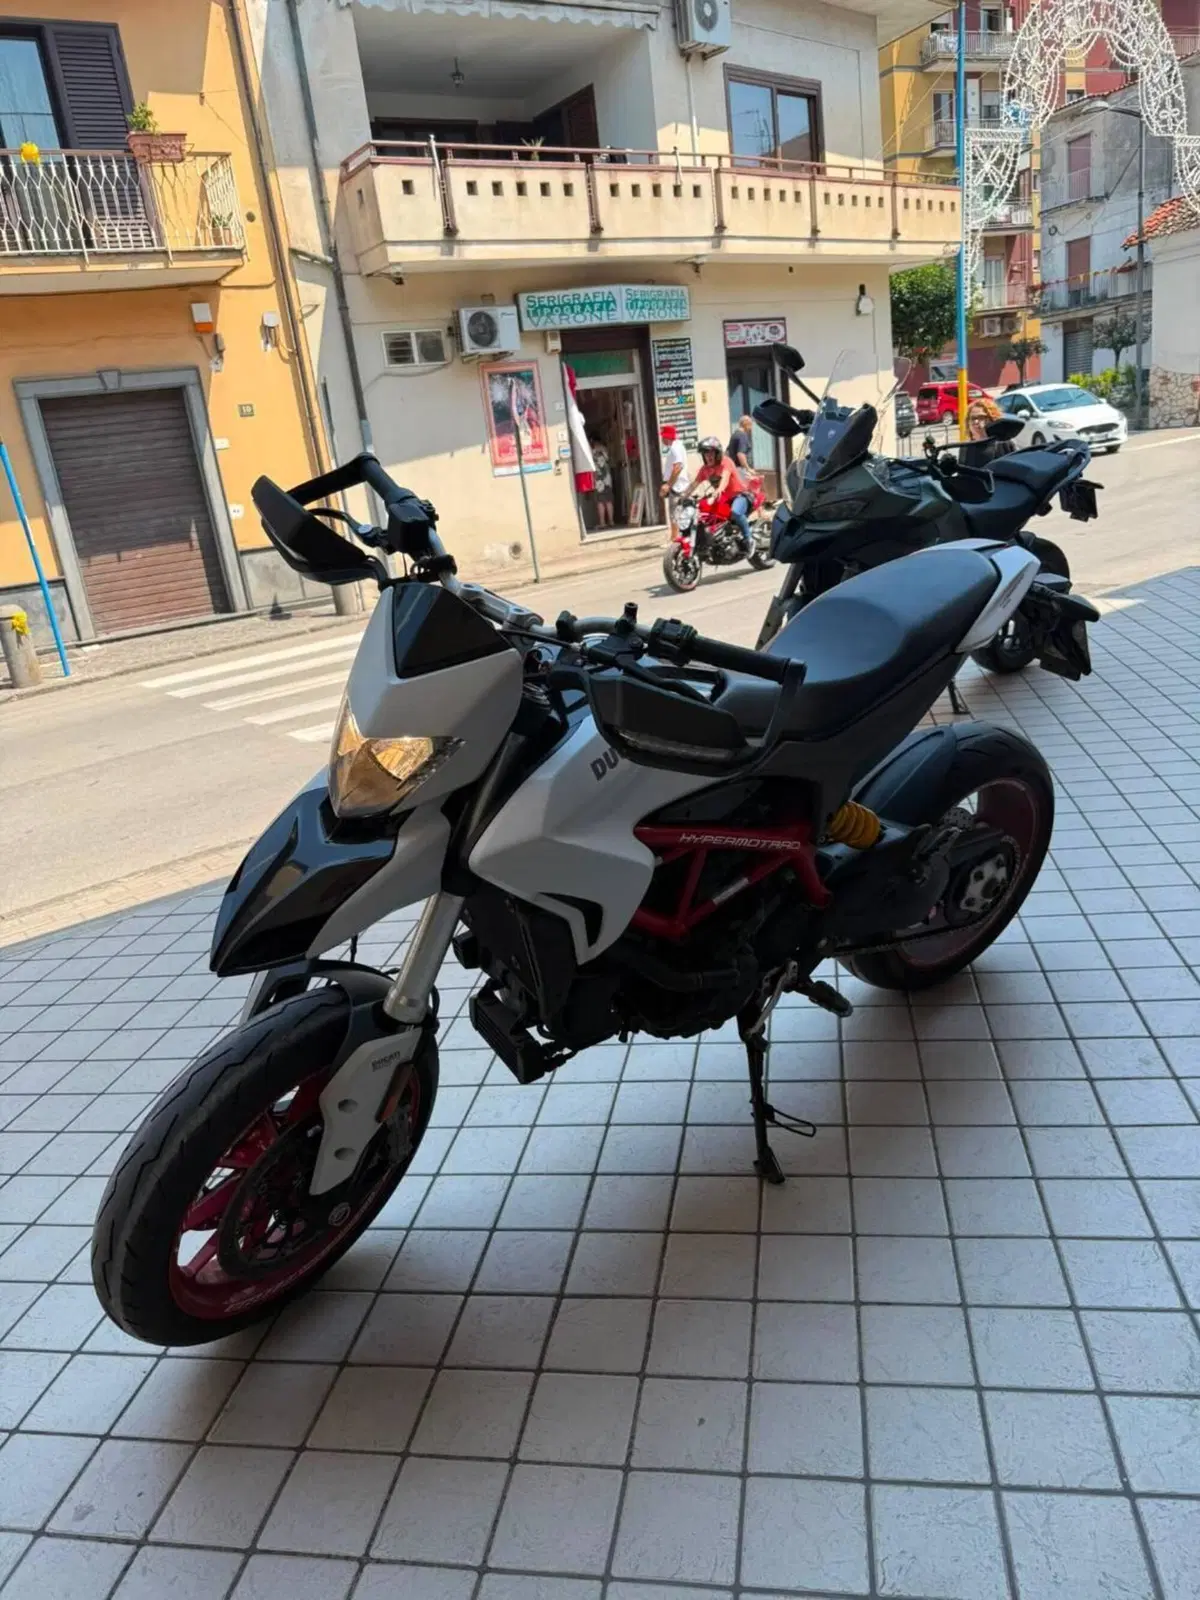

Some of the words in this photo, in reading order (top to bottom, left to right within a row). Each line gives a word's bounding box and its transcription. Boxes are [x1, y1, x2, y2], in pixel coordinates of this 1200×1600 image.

[526, 290, 616, 307] SERIGRAFIA
[625, 288, 685, 300] SERIGRAFIA
[527, 302, 617, 317] TIPOGRAFIA
[626, 300, 687, 311] TIPOGRAFIA
[527, 311, 618, 328] VARONE
[628, 309, 689, 320] VARONE
[679, 832, 801, 850] HYPERMOTARD
